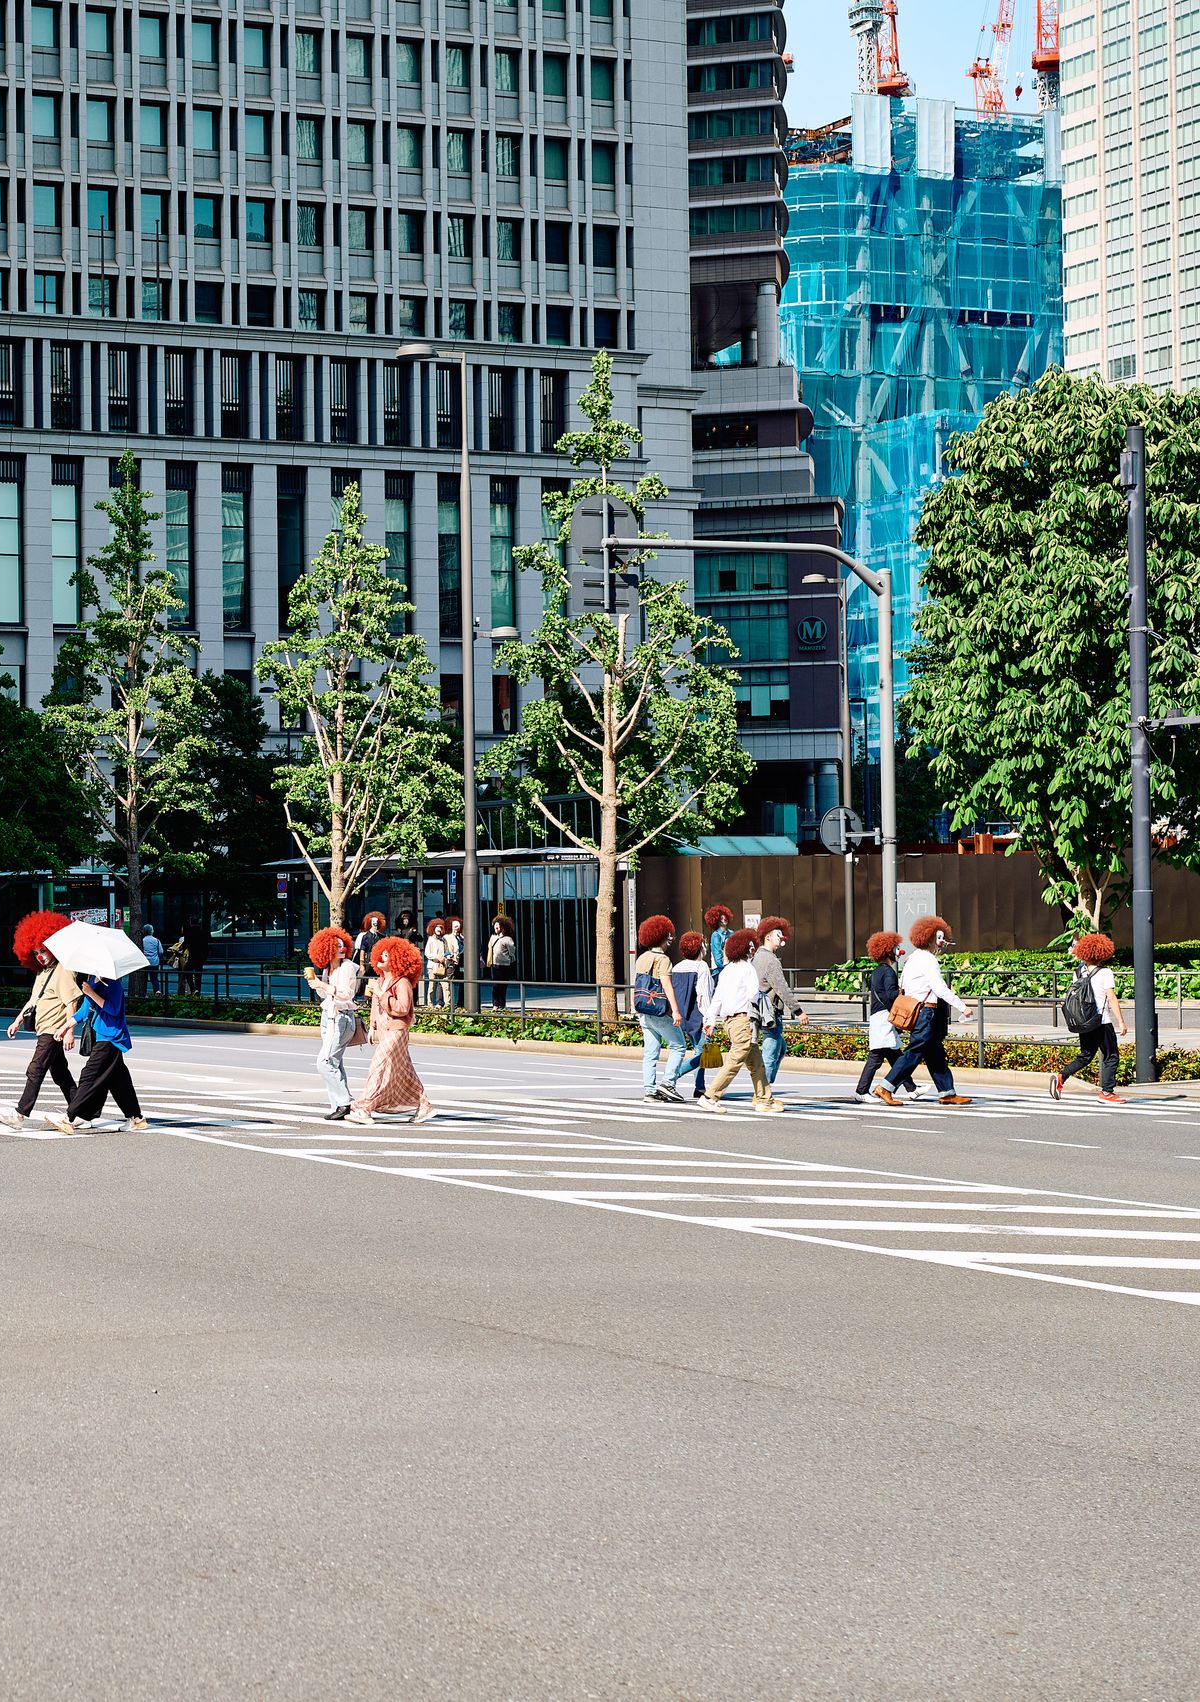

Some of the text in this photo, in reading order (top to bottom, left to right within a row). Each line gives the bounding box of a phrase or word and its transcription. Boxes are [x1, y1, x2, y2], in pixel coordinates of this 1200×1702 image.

[802, 620, 823, 640] M
[451, 870, 457, 883] P
[904, 902, 927, 914] 入口
